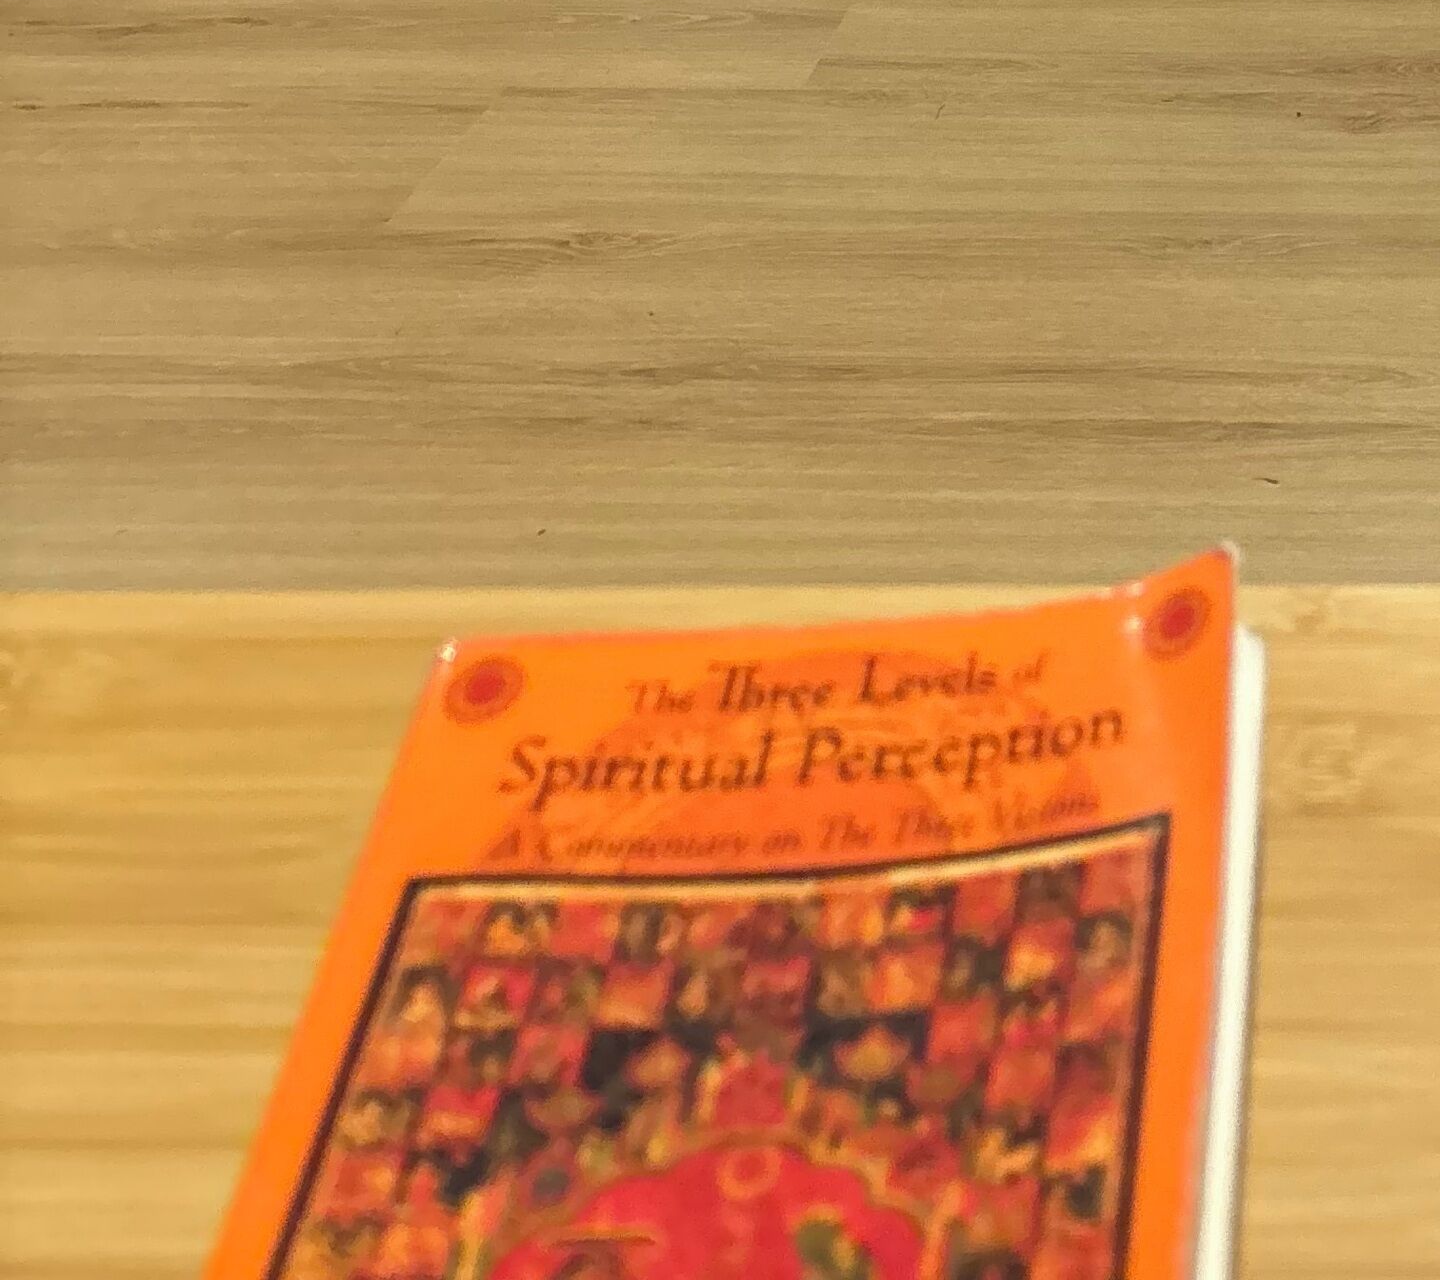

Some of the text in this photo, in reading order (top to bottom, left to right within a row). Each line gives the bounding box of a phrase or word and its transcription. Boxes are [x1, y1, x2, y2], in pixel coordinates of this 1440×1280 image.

[626, 678, 697, 715] The
[709, 659, 837, 717] Three
[857, 650, 1000, 707] Levels
[497, 708, 1125, 814] Spiritual Perception
